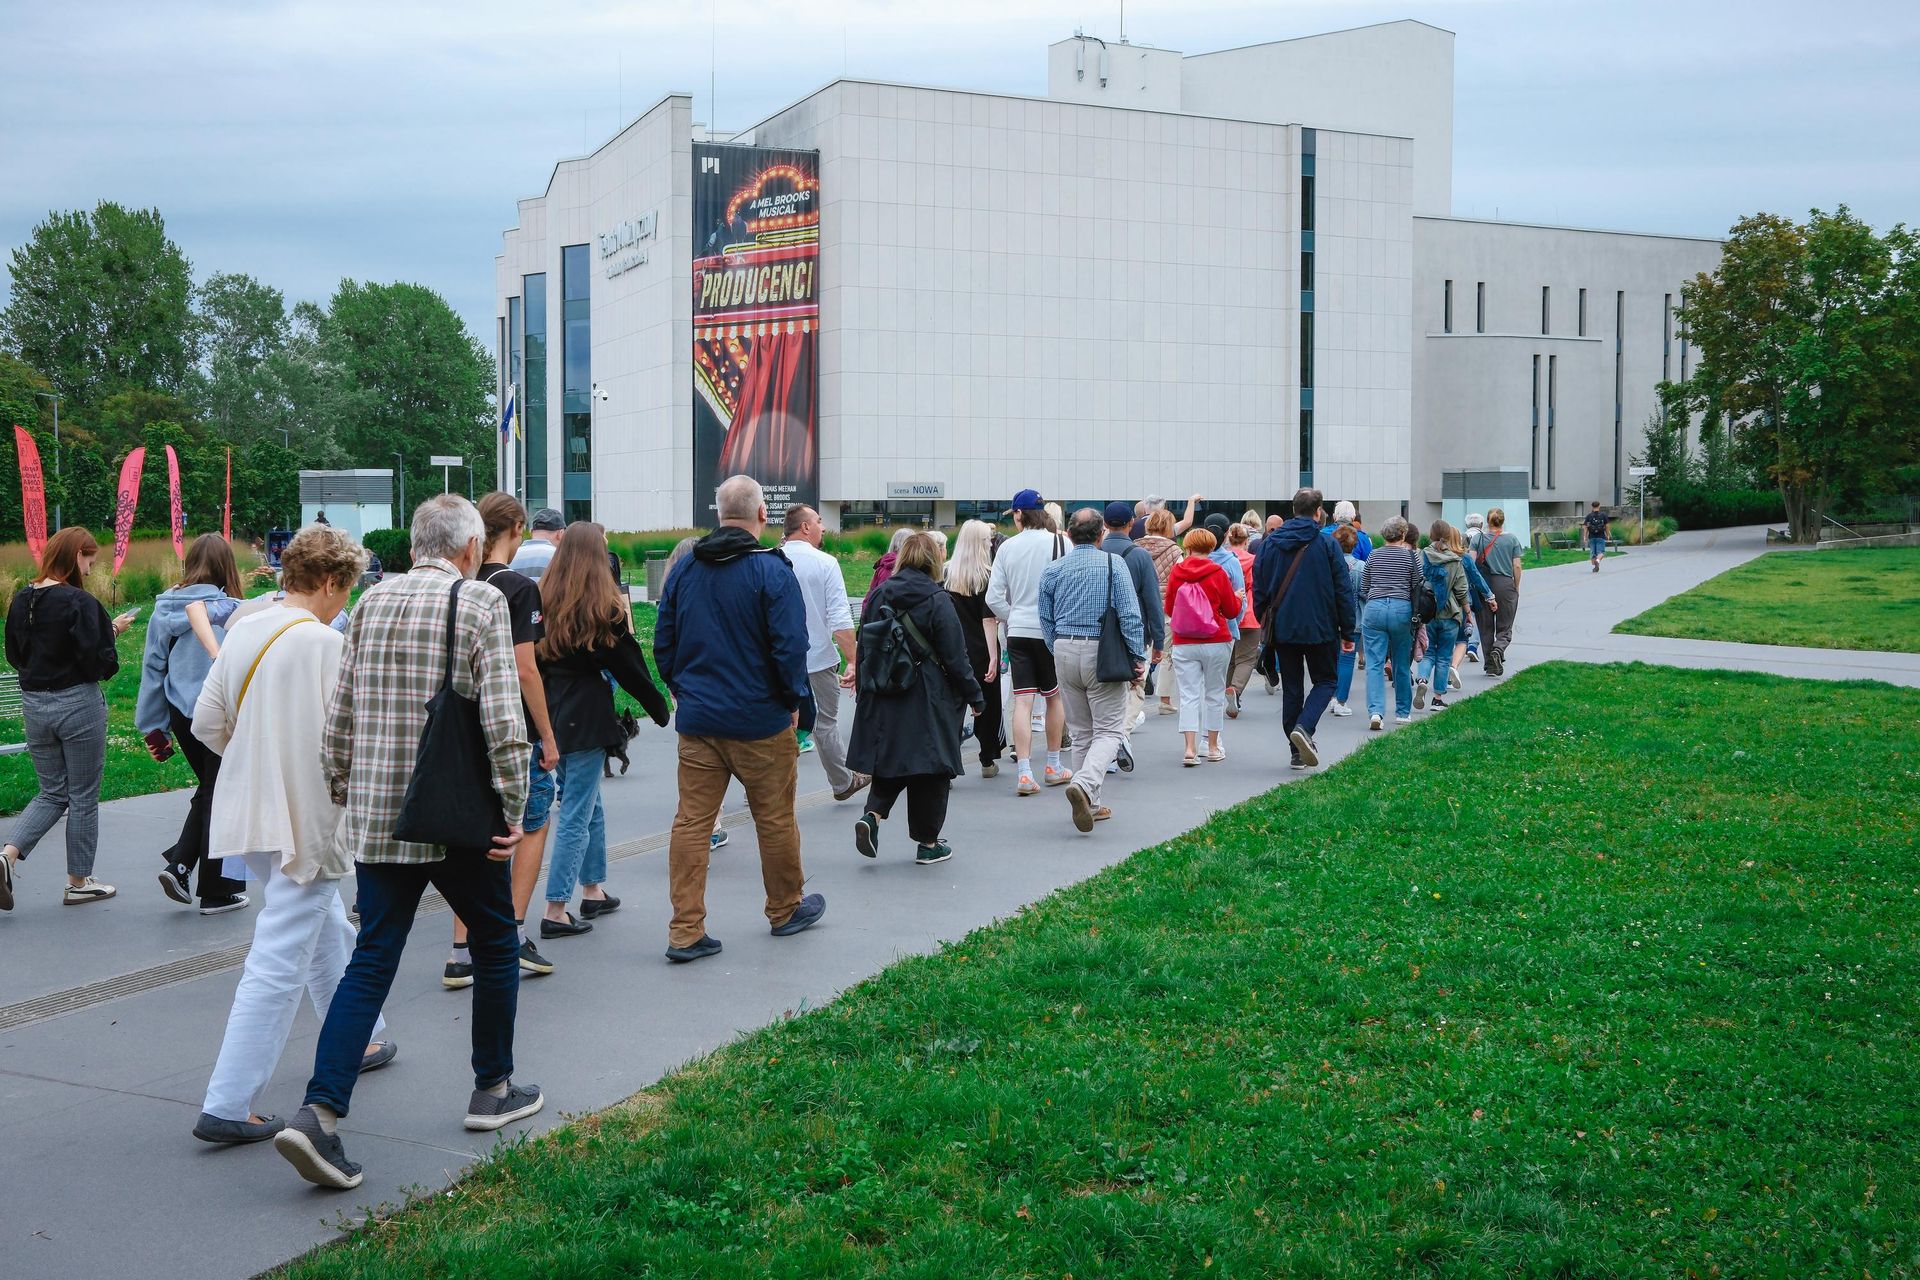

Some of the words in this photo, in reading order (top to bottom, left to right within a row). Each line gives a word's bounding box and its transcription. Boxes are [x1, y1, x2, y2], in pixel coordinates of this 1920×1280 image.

[750, 200, 756, 210] A
[757, 197, 773, 208] MEL
[774, 190, 811, 205] BROOKS
[758, 203, 797, 218] MUSICAL
[700, 261, 813, 309] PRODUCENCI
[912, 485, 939, 494] NOWA
[769, 502, 783, 510] SUSAN
